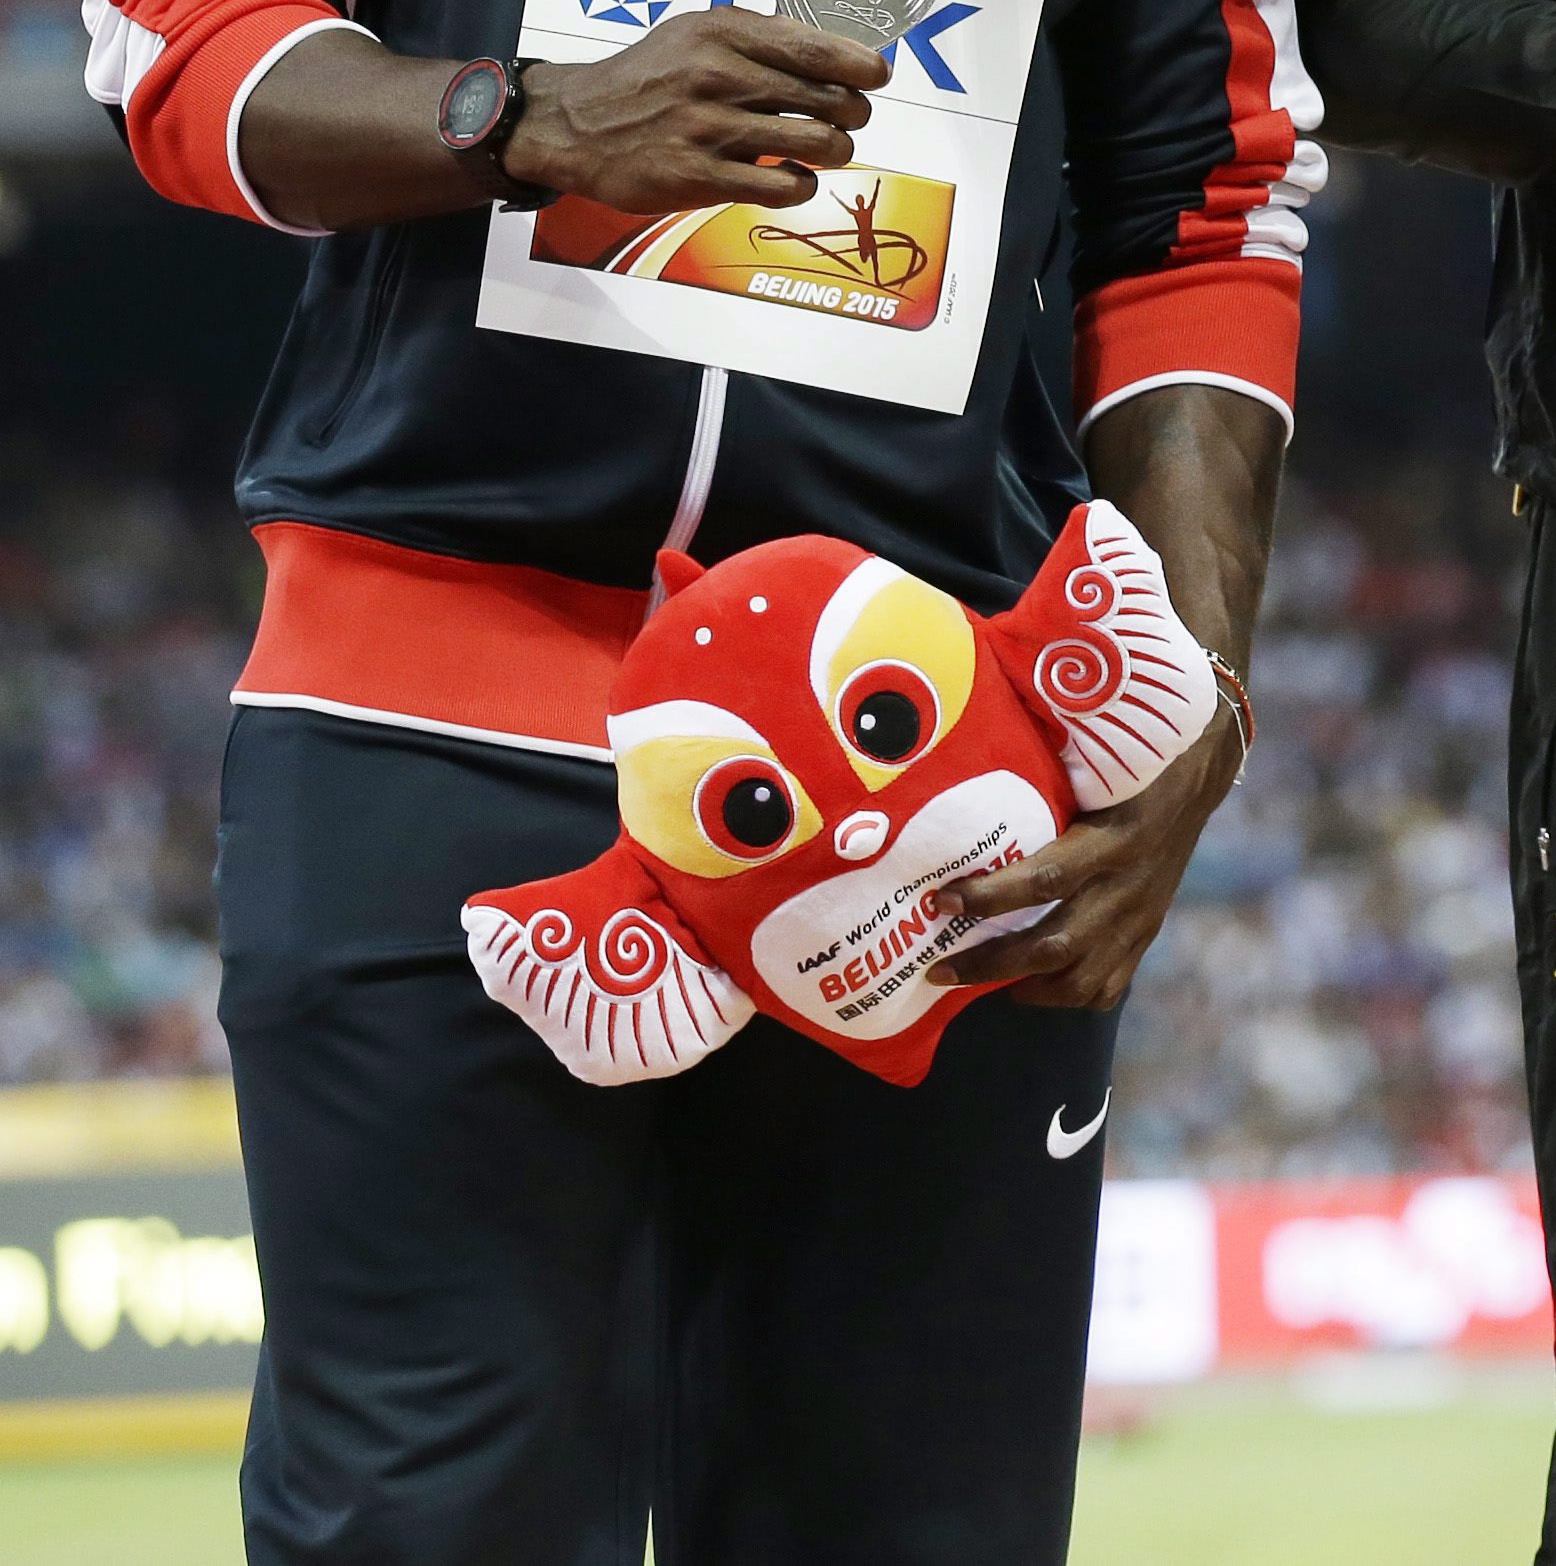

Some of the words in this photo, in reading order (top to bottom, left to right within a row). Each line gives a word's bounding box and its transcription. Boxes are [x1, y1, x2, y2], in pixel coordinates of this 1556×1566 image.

[748, 272, 842, 308] BEIJING
[843, 291, 899, 320] 2015
[797, 942, 841, 974] IAAF
[845, 901, 891, 946] World
[893, 821, 1008, 905] Championships
